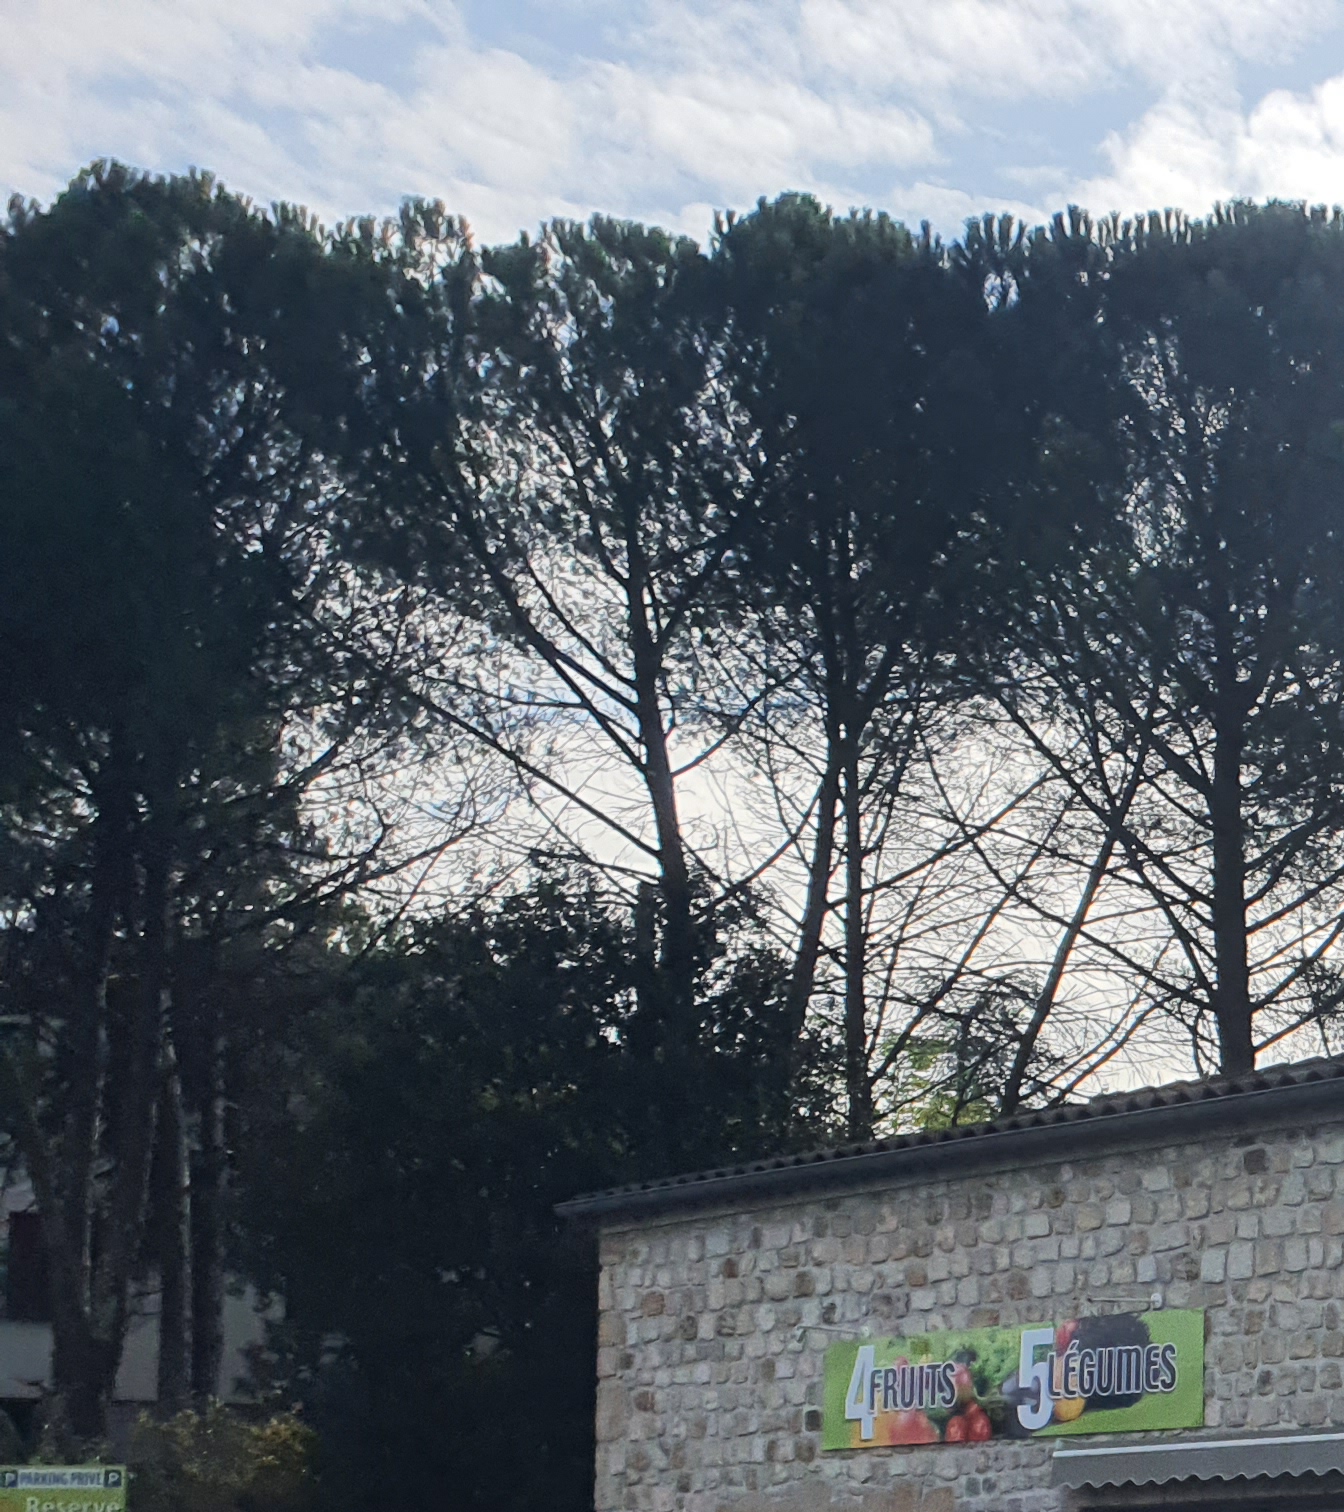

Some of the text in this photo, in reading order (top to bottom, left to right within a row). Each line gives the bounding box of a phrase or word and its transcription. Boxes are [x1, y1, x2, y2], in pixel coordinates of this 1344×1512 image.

[844, 1345, 877, 1441] 4
[868, 1361, 957, 1413] FRUITS
[1014, 1328, 1054, 1431] 5
